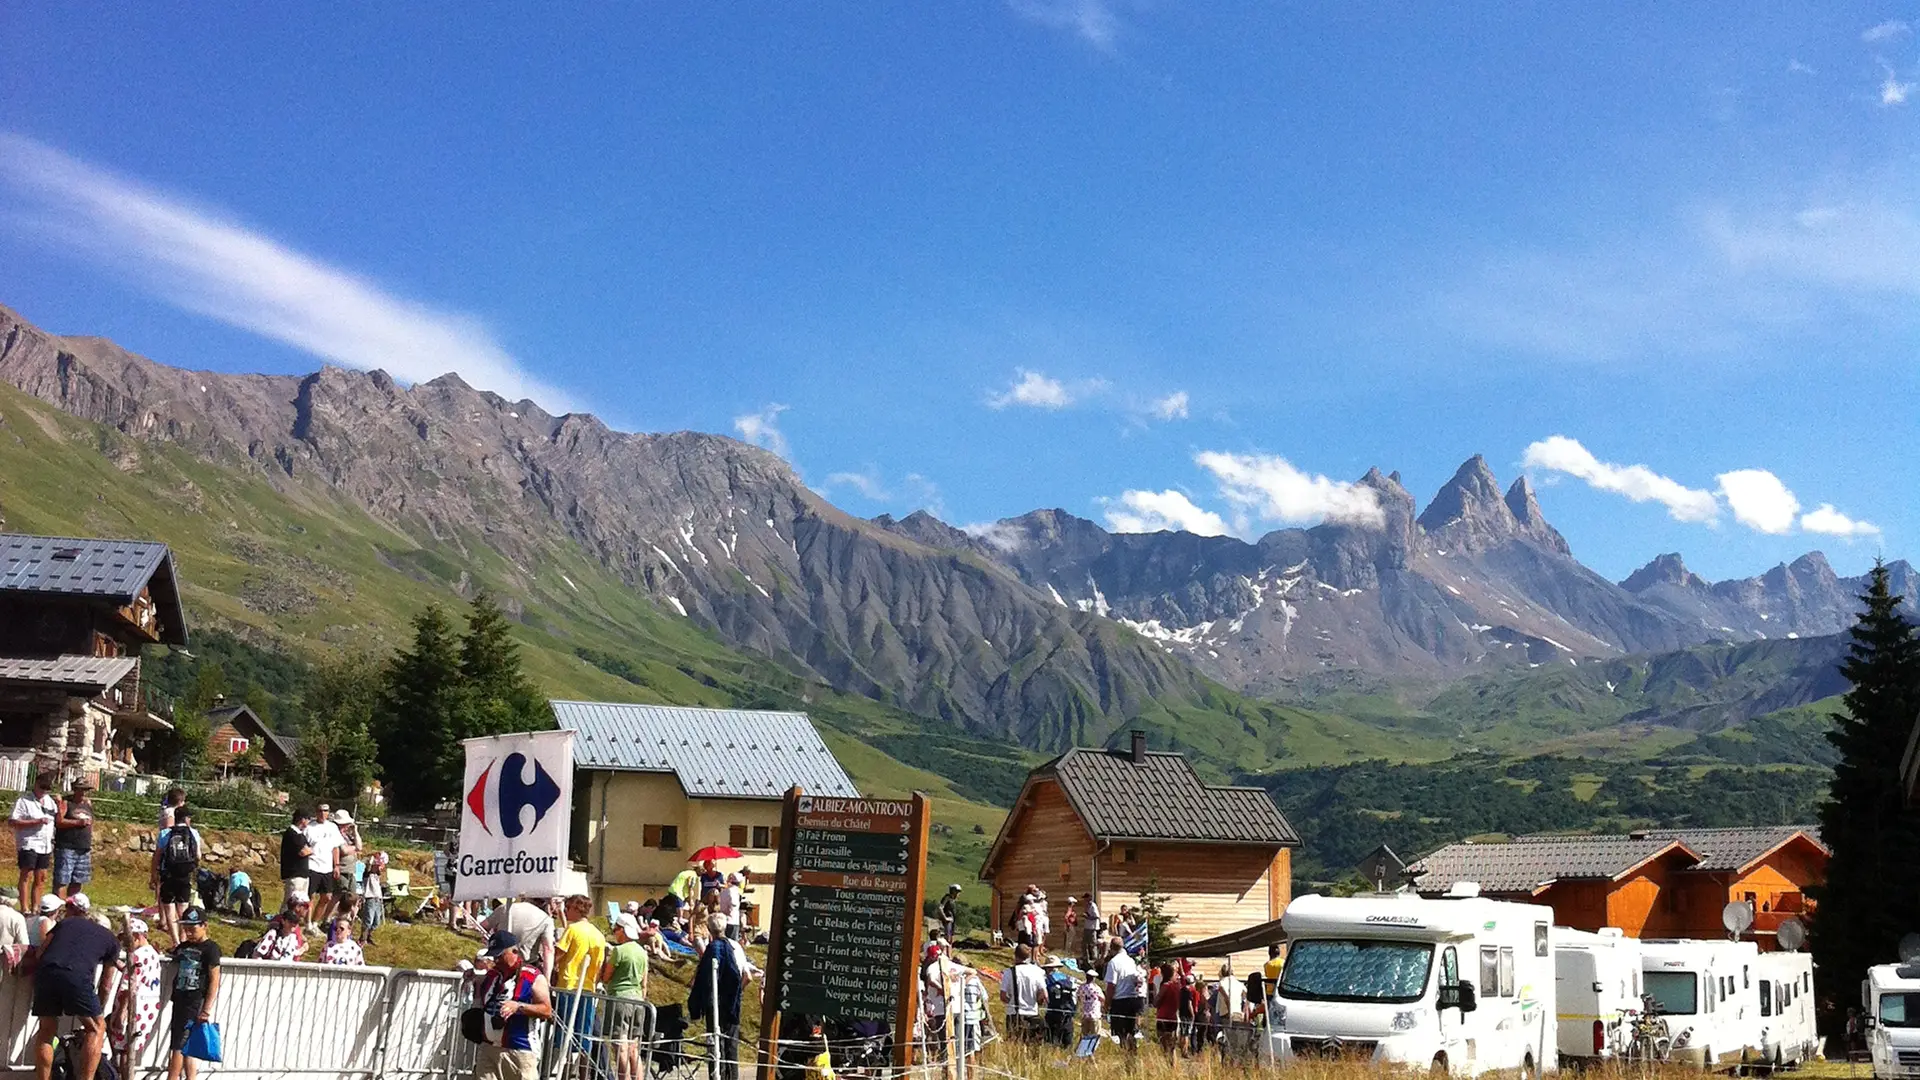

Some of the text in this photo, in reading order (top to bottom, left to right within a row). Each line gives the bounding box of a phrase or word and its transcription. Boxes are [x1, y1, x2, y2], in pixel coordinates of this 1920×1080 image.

[812, 799, 913, 816] ALBIEZ-MONTROND
[797, 815, 872, 830] Chemin du Châtel
[804, 844, 815, 854] Le
[460, 850, 558, 877] Carrefour
[803, 857, 896, 874] Le Hameau des Aiguilles
[843, 875, 859, 886] Rue
[860, 876, 872, 887] du
[835, 889, 906, 903] Tous commerces
[803, 900, 884, 919] Remontées Mécaniques
[813, 916, 893, 933] Le Relais des Pistes
[831, 932, 845, 942] Les
[815, 944, 891, 962] Le Front de Neige
[812, 959, 889, 977] La Pierre aux Fées
[822, 975, 888, 991] L'Altitude 1600
[825, 989, 888, 1005] Neige et Soleil
[840, 1006, 850, 1016] Le
